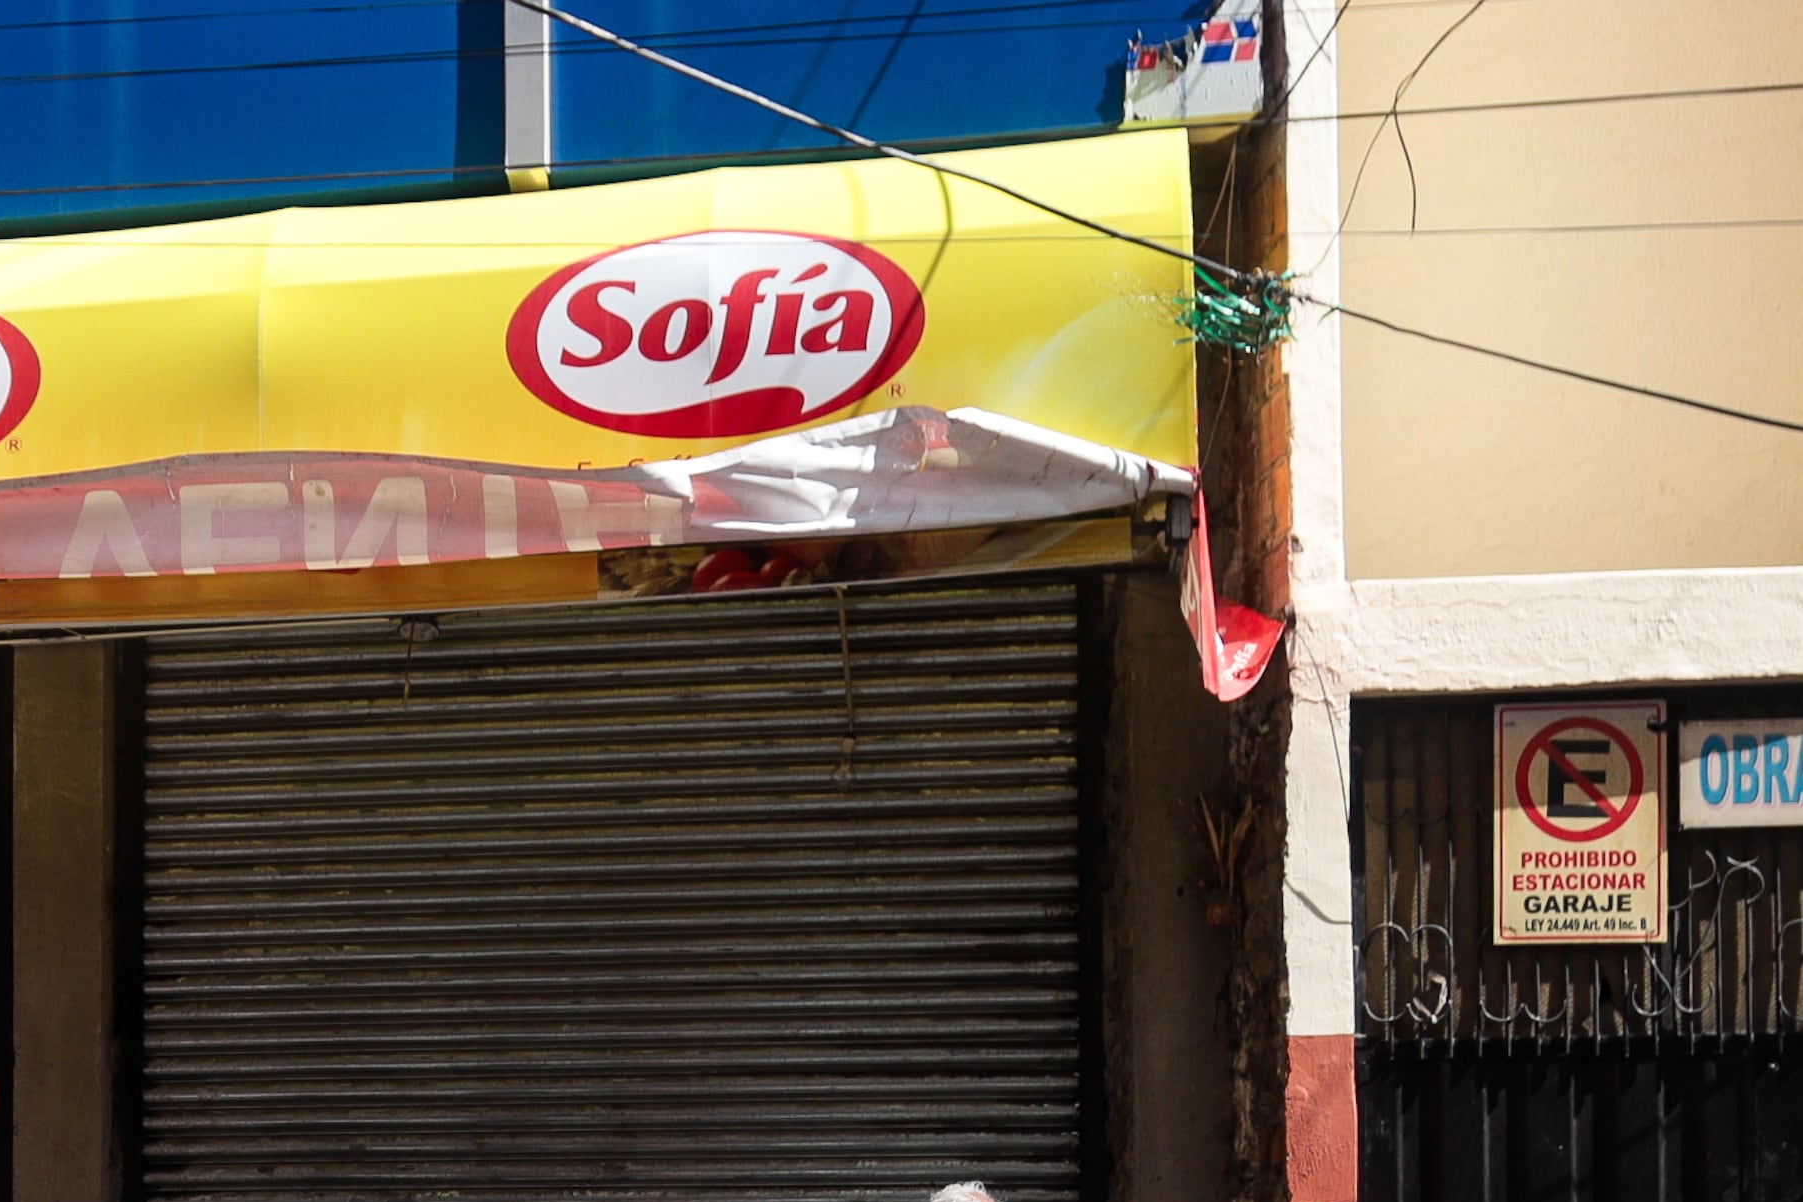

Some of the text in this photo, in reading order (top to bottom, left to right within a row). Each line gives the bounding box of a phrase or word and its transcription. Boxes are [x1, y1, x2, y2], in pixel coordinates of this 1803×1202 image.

[560, 263, 875, 385] Sofía
[1547, 739, 1611, 818] E
[1521, 850, 1637, 869] PROHIBIDO
[1512, 873, 1646, 891] ESTACIONAR
[1523, 894, 1632, 914] GARAJE
[1525, 919, 1544, 932] LEY
[1583, 918, 1601, 931] Art.
[1604, 918, 1616, 930] 49
[1619, 918, 1637, 930] Inc.
